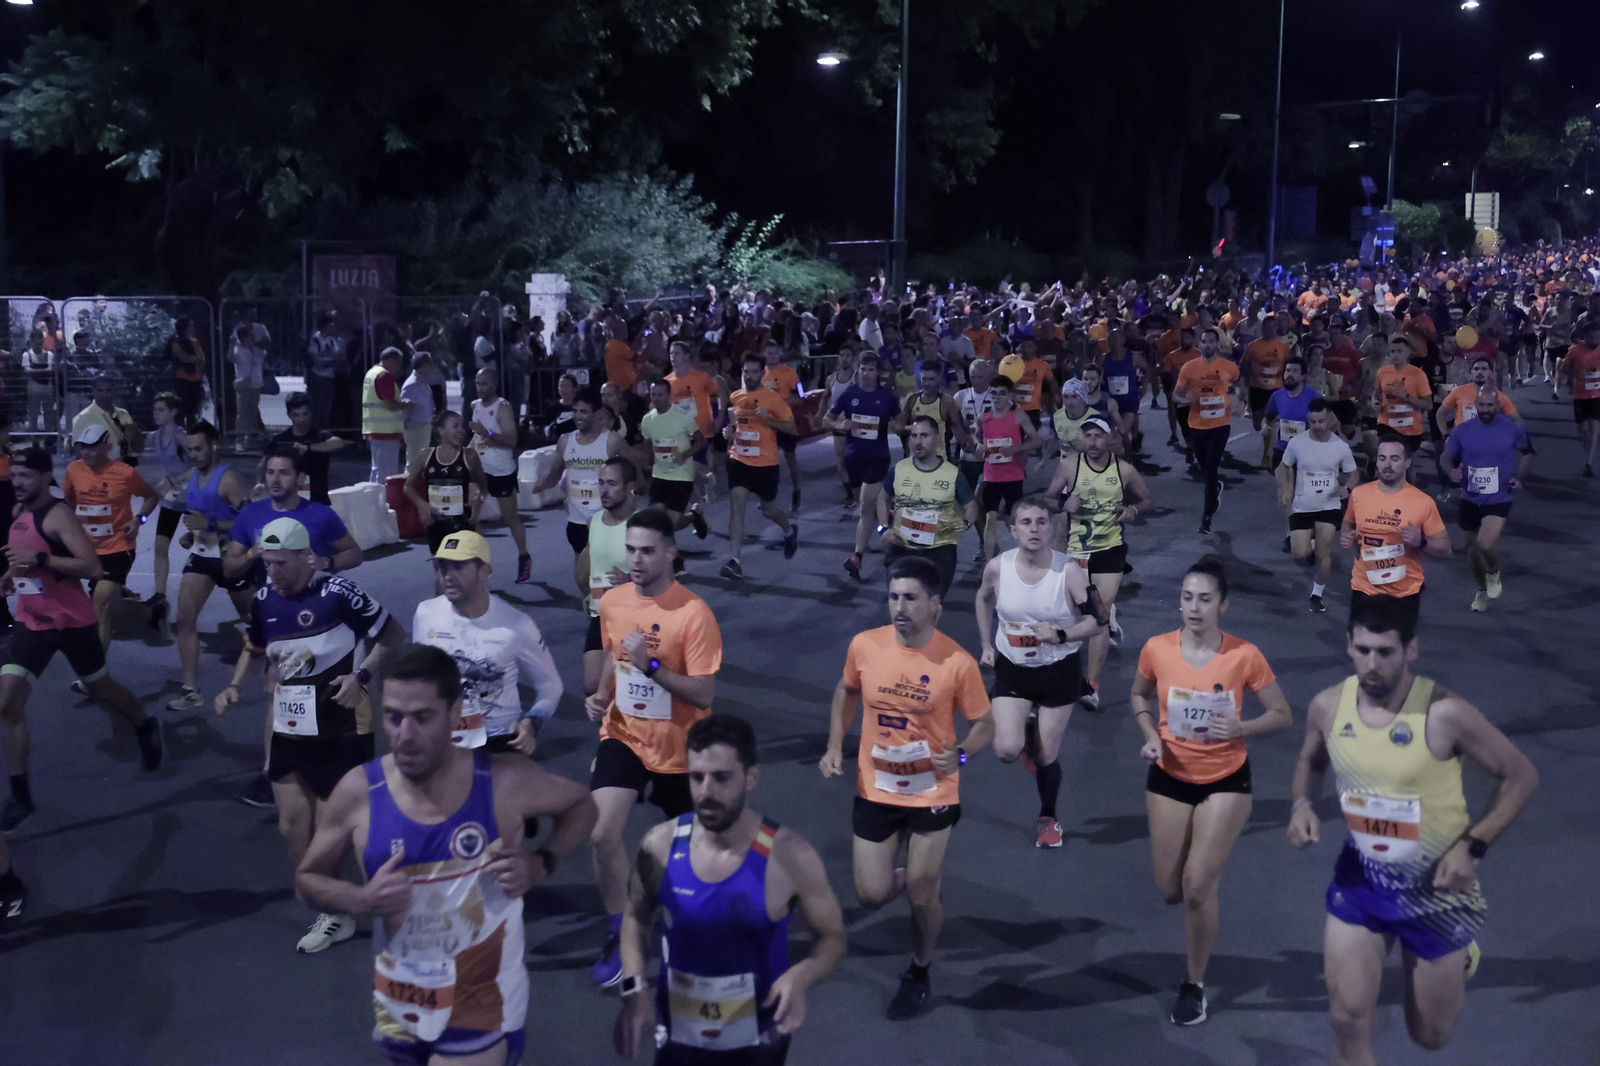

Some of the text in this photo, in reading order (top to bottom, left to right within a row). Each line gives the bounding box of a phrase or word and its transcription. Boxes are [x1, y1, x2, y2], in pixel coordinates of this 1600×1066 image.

[330, 268, 380, 289] LUZIA
[567, 457, 604, 466] eMotion
[1310, 479, 1330, 487] 18712
[1474, 476, 1491, 484] 6230
[580, 489, 593, 498] 178
[911, 521, 925, 531] 507
[1375, 558, 1397, 570] 1032
[628, 682, 655, 698] 3731
[877, 686, 910, 699] SEVILLA
[279, 702, 306, 715] 17426
[1363, 818, 1398, 837] 1471
[700, 1002, 722, 1020] 43
